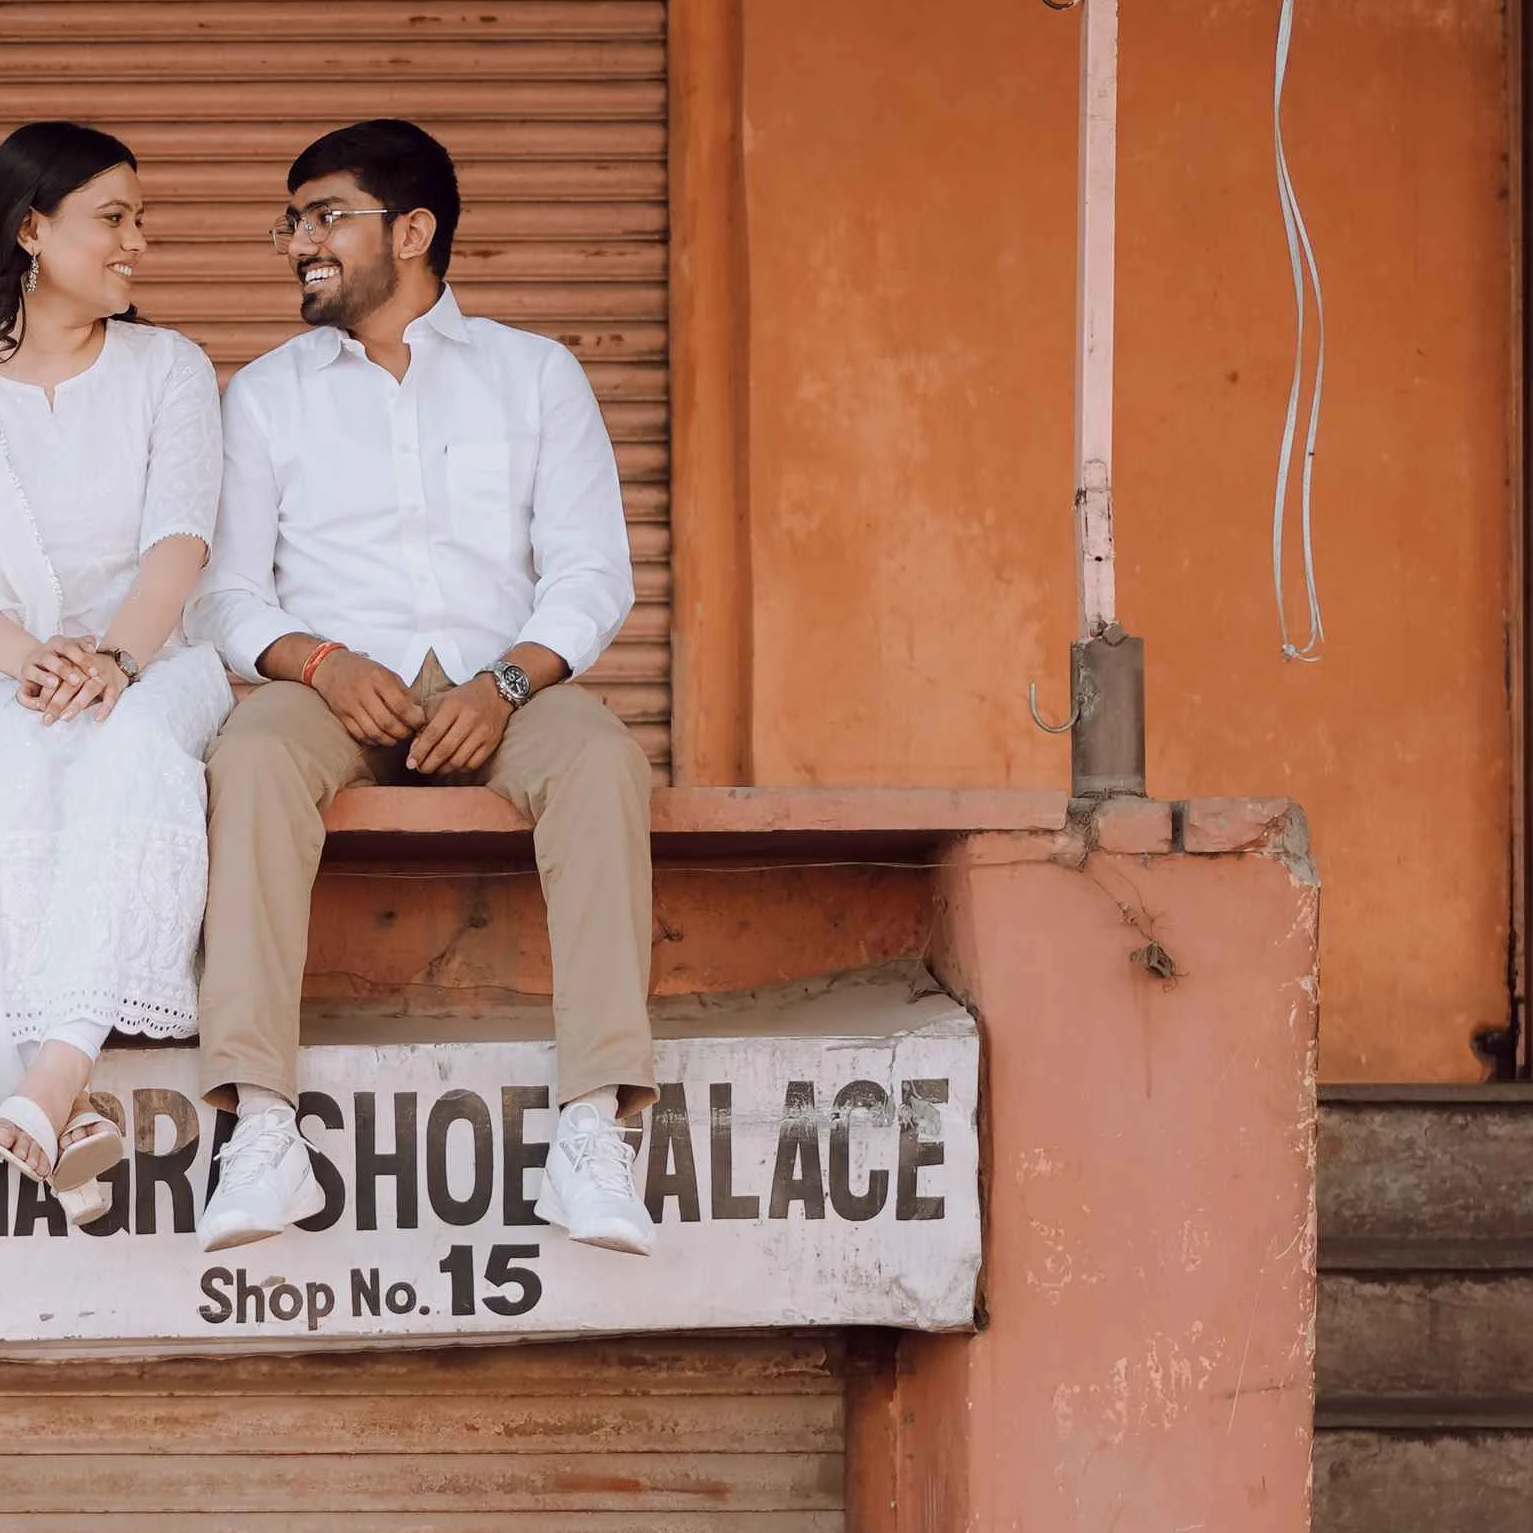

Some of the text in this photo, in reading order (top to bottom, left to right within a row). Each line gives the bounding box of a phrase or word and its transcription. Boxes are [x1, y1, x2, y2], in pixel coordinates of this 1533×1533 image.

[295, 1085, 551, 1232] SHOE
[618, 1078, 950, 1223] ALACE
[199, 1243, 543, 1331] Shop No. 15
